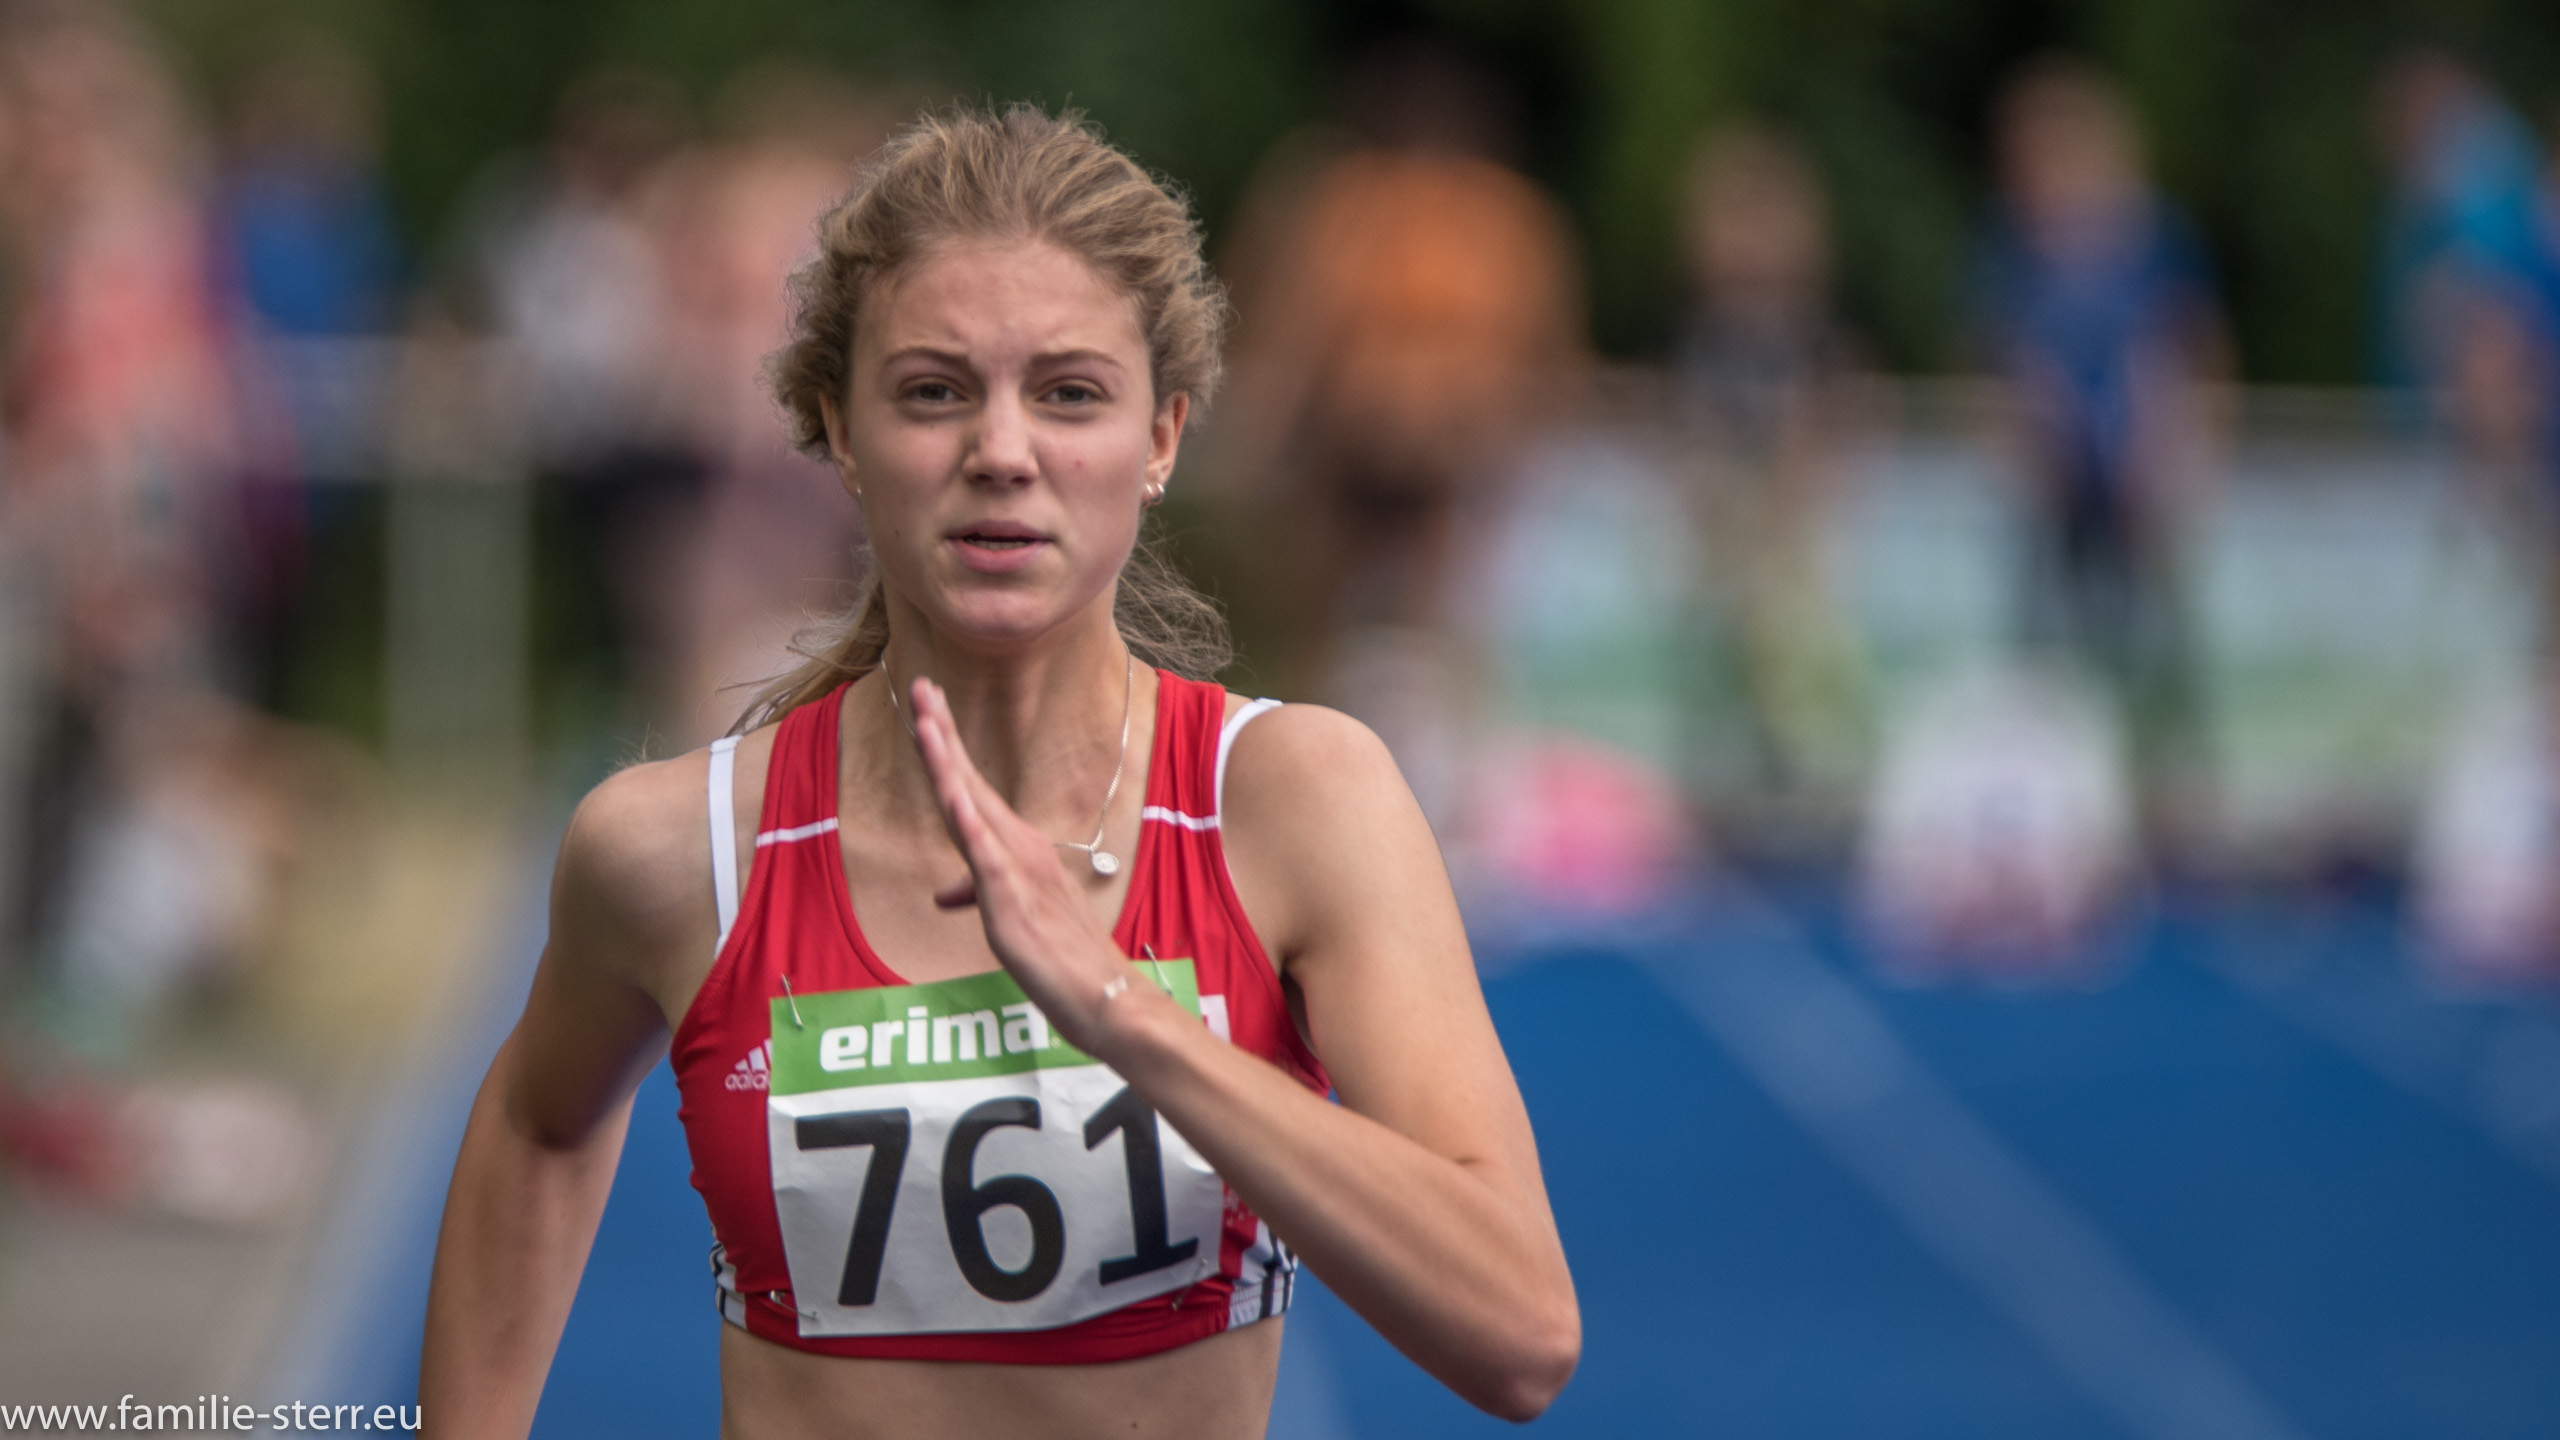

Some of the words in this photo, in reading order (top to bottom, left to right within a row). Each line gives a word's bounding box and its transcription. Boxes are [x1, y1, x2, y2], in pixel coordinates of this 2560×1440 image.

[819, 1001, 1050, 1072] erima
[724, 1069, 770, 1090] adid
[793, 1083, 1199, 1307] 761
